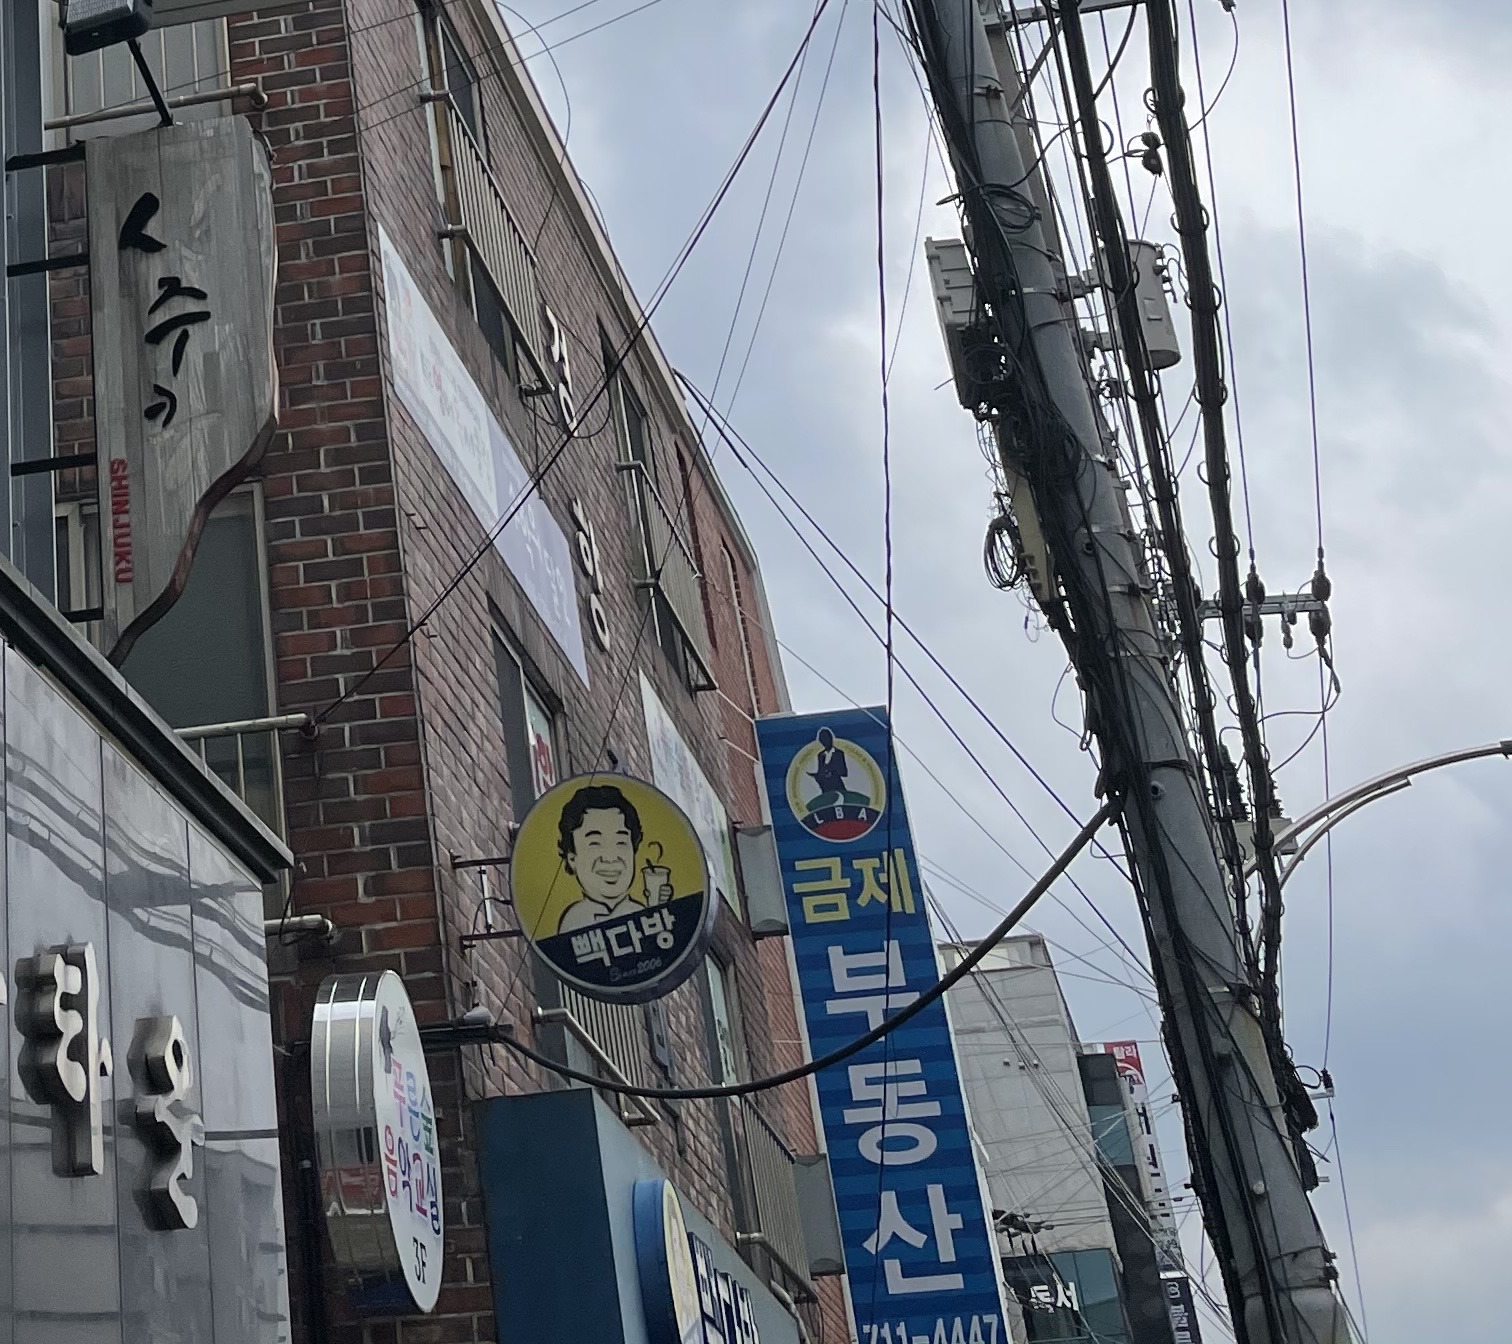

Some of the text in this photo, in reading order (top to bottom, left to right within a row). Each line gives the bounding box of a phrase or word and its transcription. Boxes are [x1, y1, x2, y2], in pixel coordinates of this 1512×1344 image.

[109, 457, 134, 585] SHINJUKU
[813, 806, 868, 825] LBA
[790, 847, 917, 924] 금제
[570, 907, 677, 968] 빽다방
[824, 940, 967, 1296] 부동산
[412, 1236, 428, 1285] 3F
